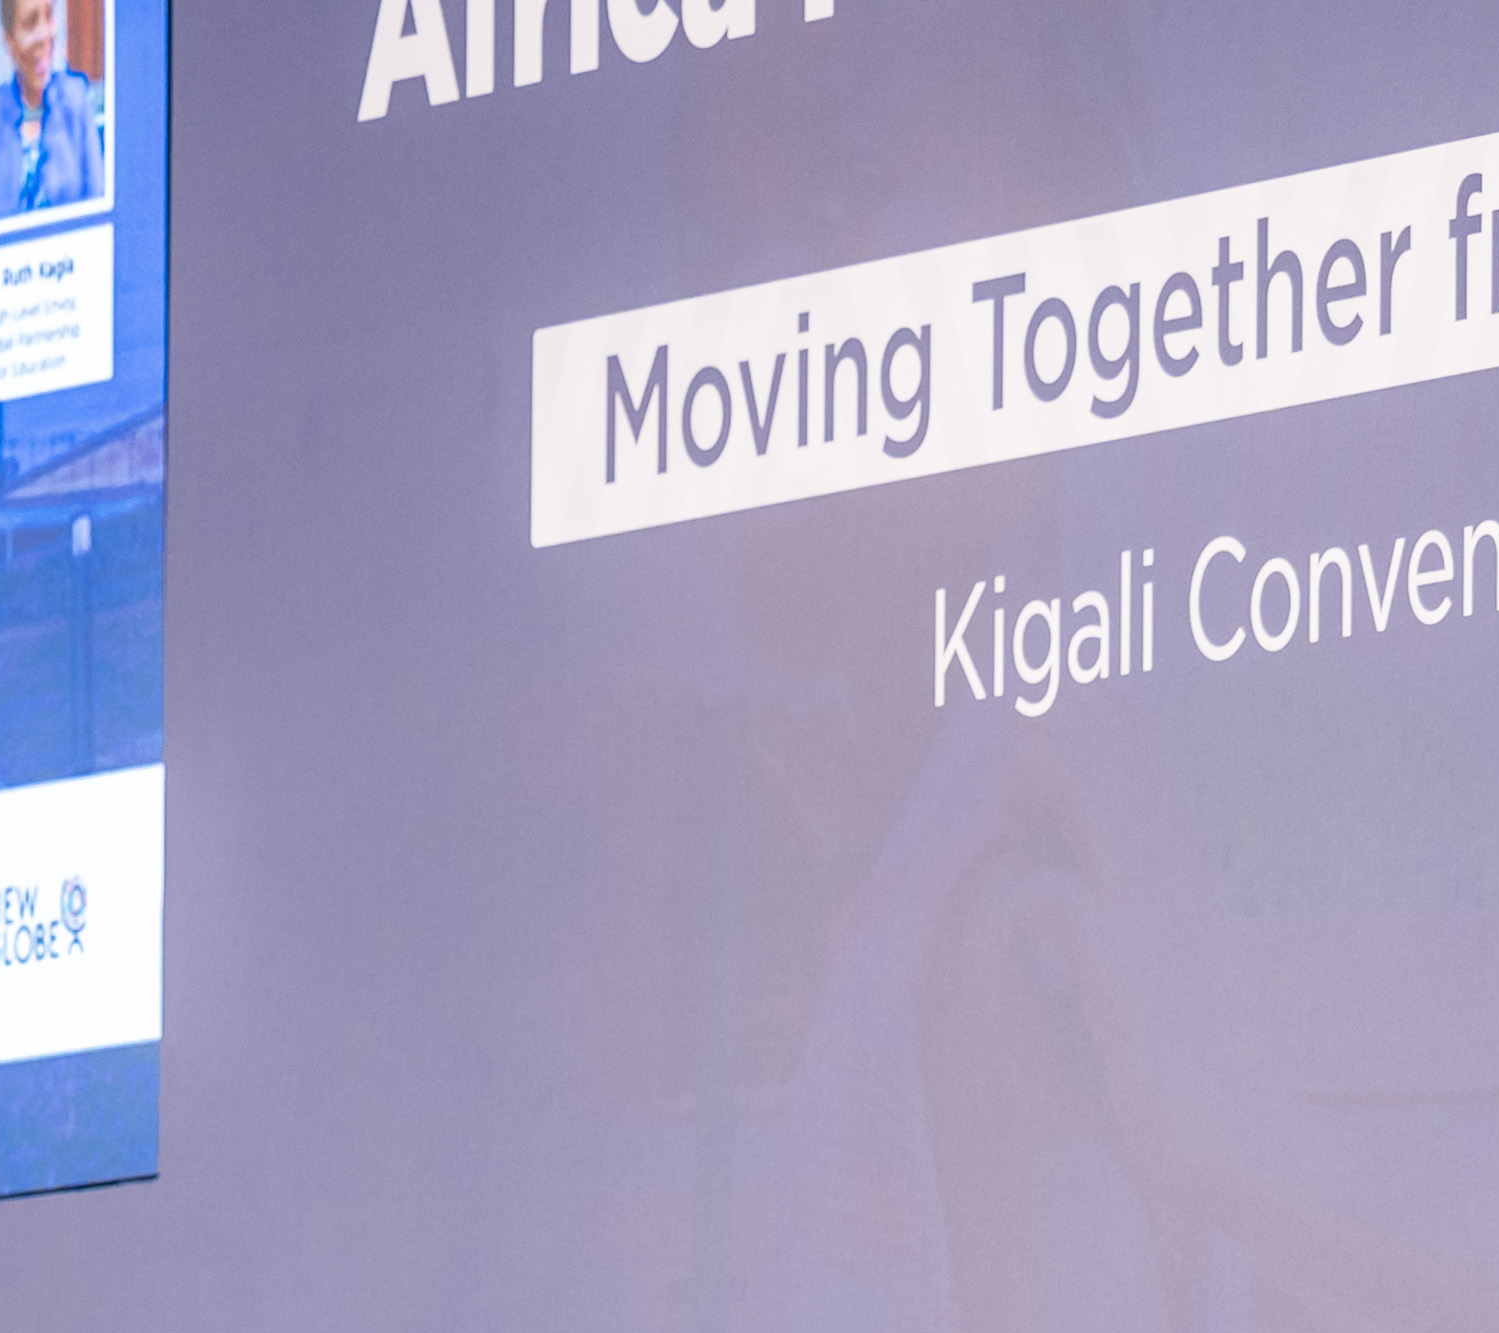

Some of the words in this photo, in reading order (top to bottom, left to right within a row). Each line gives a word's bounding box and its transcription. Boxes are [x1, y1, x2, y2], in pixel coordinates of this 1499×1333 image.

[605, 312, 932, 485] Moving
[972, 217, 1411, 420] Together
[934, 550, 1154, 718] Kigali
